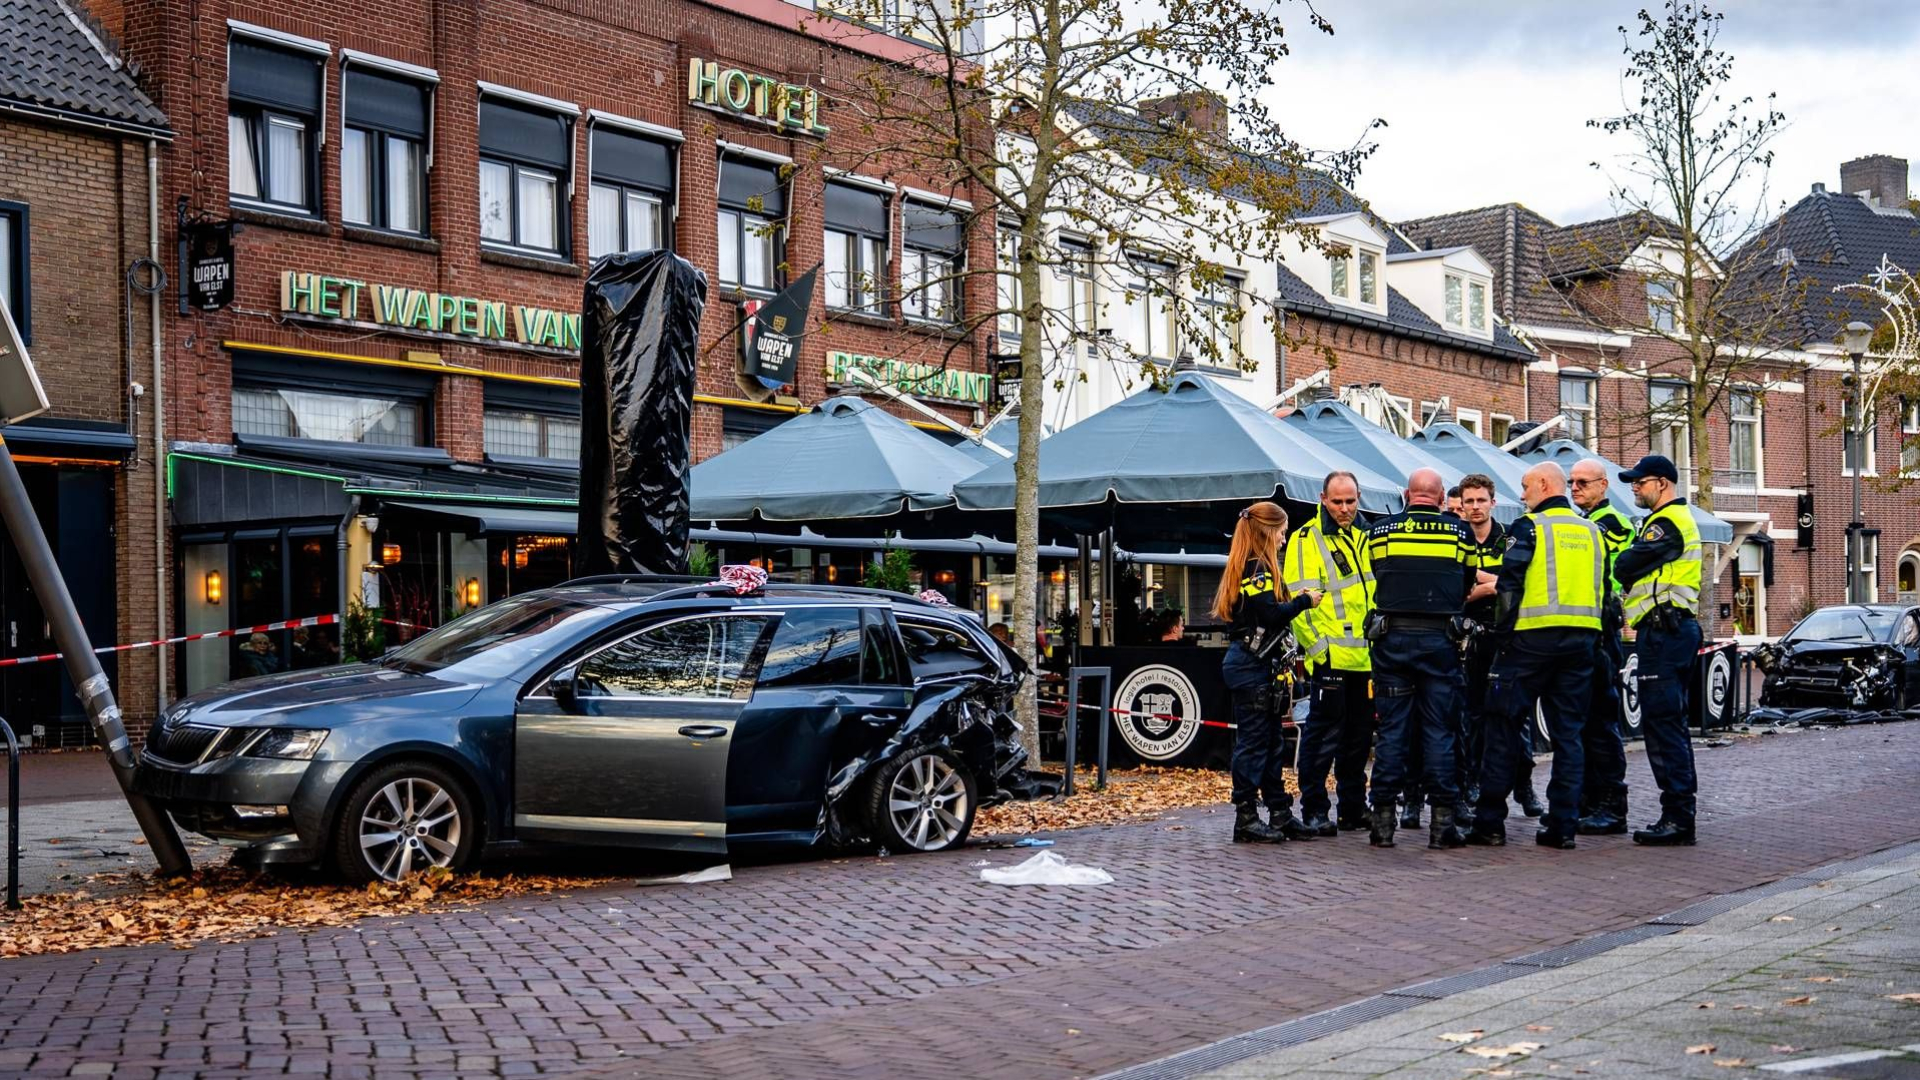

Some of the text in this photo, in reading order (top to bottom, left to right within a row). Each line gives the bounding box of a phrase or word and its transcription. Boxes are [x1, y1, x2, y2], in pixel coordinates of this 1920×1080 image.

[689, 58, 830, 133] HOTEL
[194, 263, 229, 282] WAPEN
[199, 281, 223, 292] VAN ELST
[281, 271, 582, 348] HET WAPEN VAN
[757, 337, 793, 358] WAPEN
[760, 352, 784, 365] VAN ELST
[1123, 686, 1137, 704] logis
[1135, 674, 1155, 687] hotel
[1161, 674, 1190, 705] restaurant
[1122, 717, 1133, 734] HET
[1131, 734, 1160, 751] WAPEN
[1161, 738, 1179, 751] VAN
